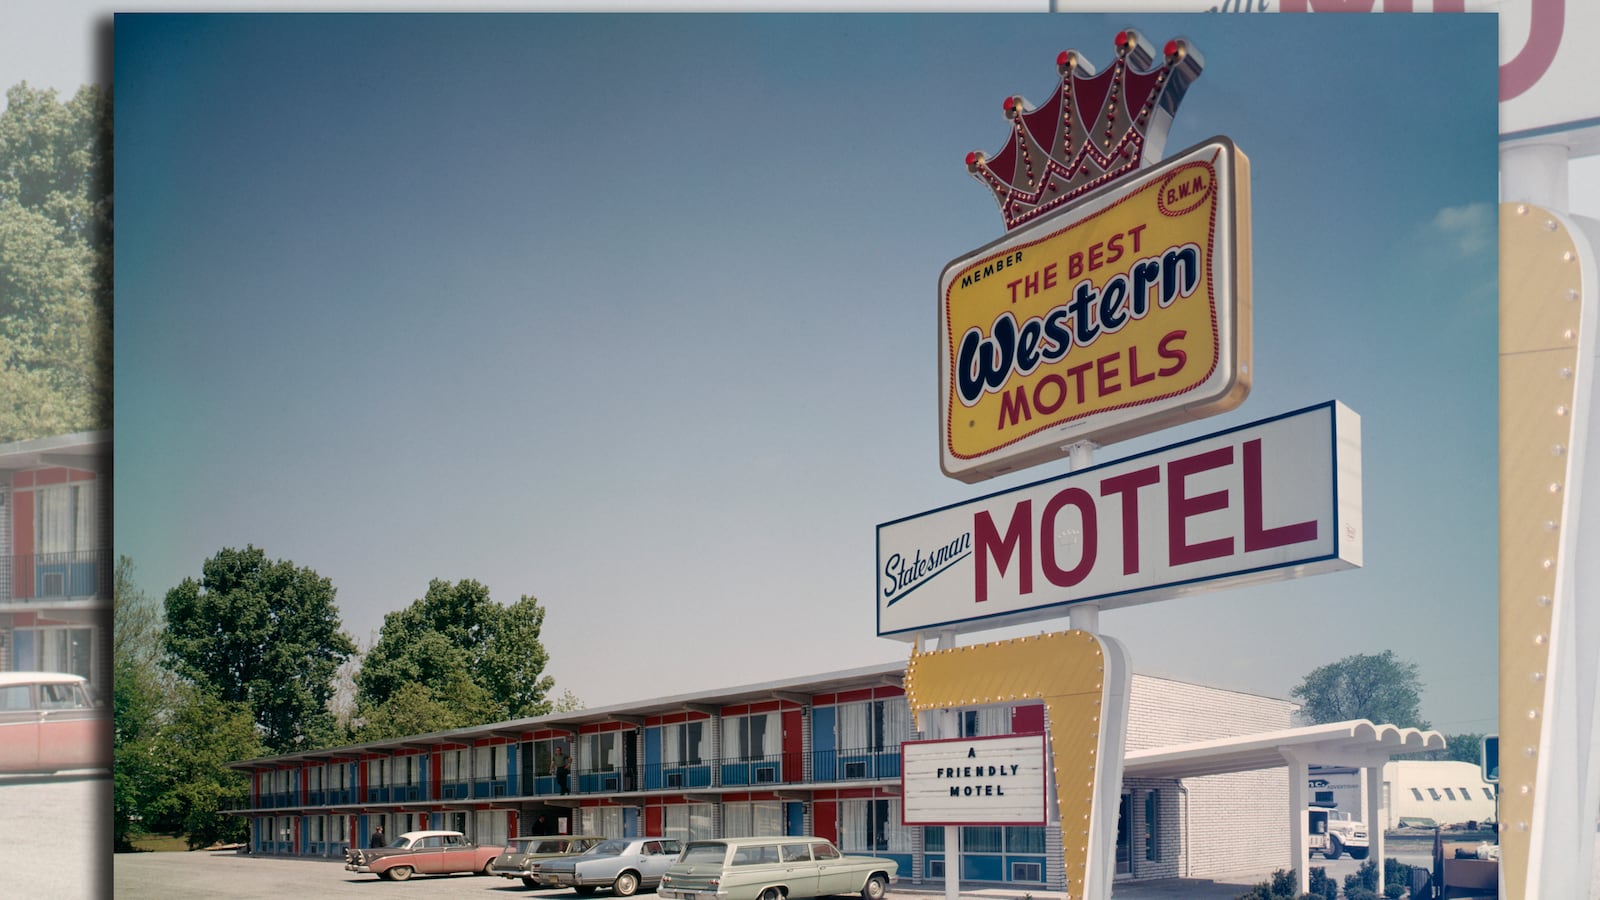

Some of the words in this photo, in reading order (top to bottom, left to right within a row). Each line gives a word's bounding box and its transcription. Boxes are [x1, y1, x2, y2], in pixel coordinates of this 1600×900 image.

[1166, 176, 1207, 206] B.W.M.
[961, 251, 1024, 289] MEMBER
[1007, 262, 1057, 304] THE
[1069, 224, 1147, 281] BEST
[957, 246, 1198, 402] Western
[997, 330, 1188, 431] MOTELS
[883, 531, 973, 599] Statesman
[974, 438, 1318, 603] MOTEL
[937, 764, 1019, 778] FRIENDLY
[967, 747, 976, 758] A
[950, 785, 1004, 797] MOTEL
